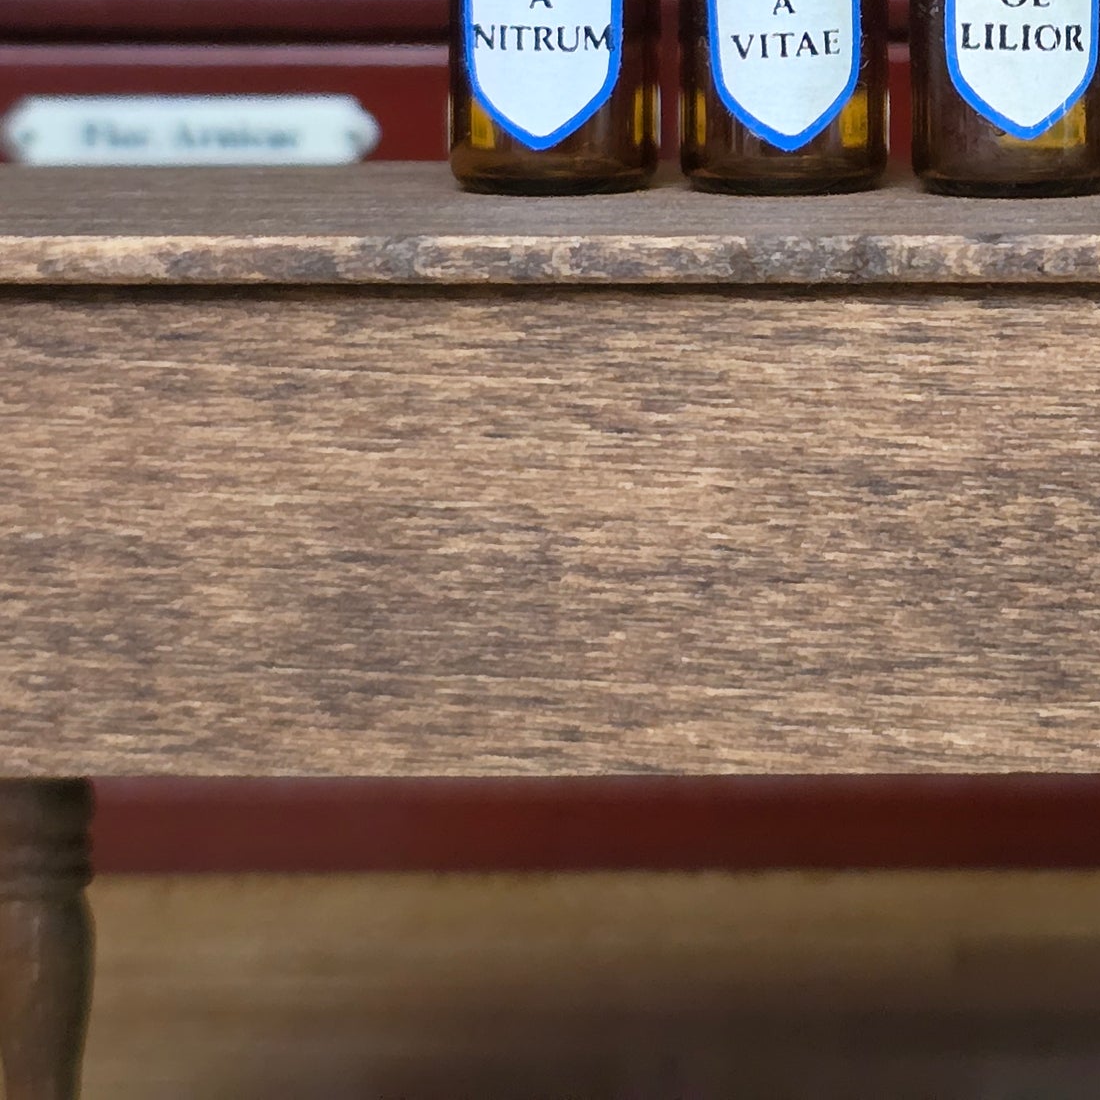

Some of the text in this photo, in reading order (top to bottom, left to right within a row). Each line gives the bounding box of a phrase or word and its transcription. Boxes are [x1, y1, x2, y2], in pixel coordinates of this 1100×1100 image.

[473, 23, 614, 53] NITRUM
[730, 29, 841, 60] VITAE
[961, 23, 1084, 52] LILIOR
